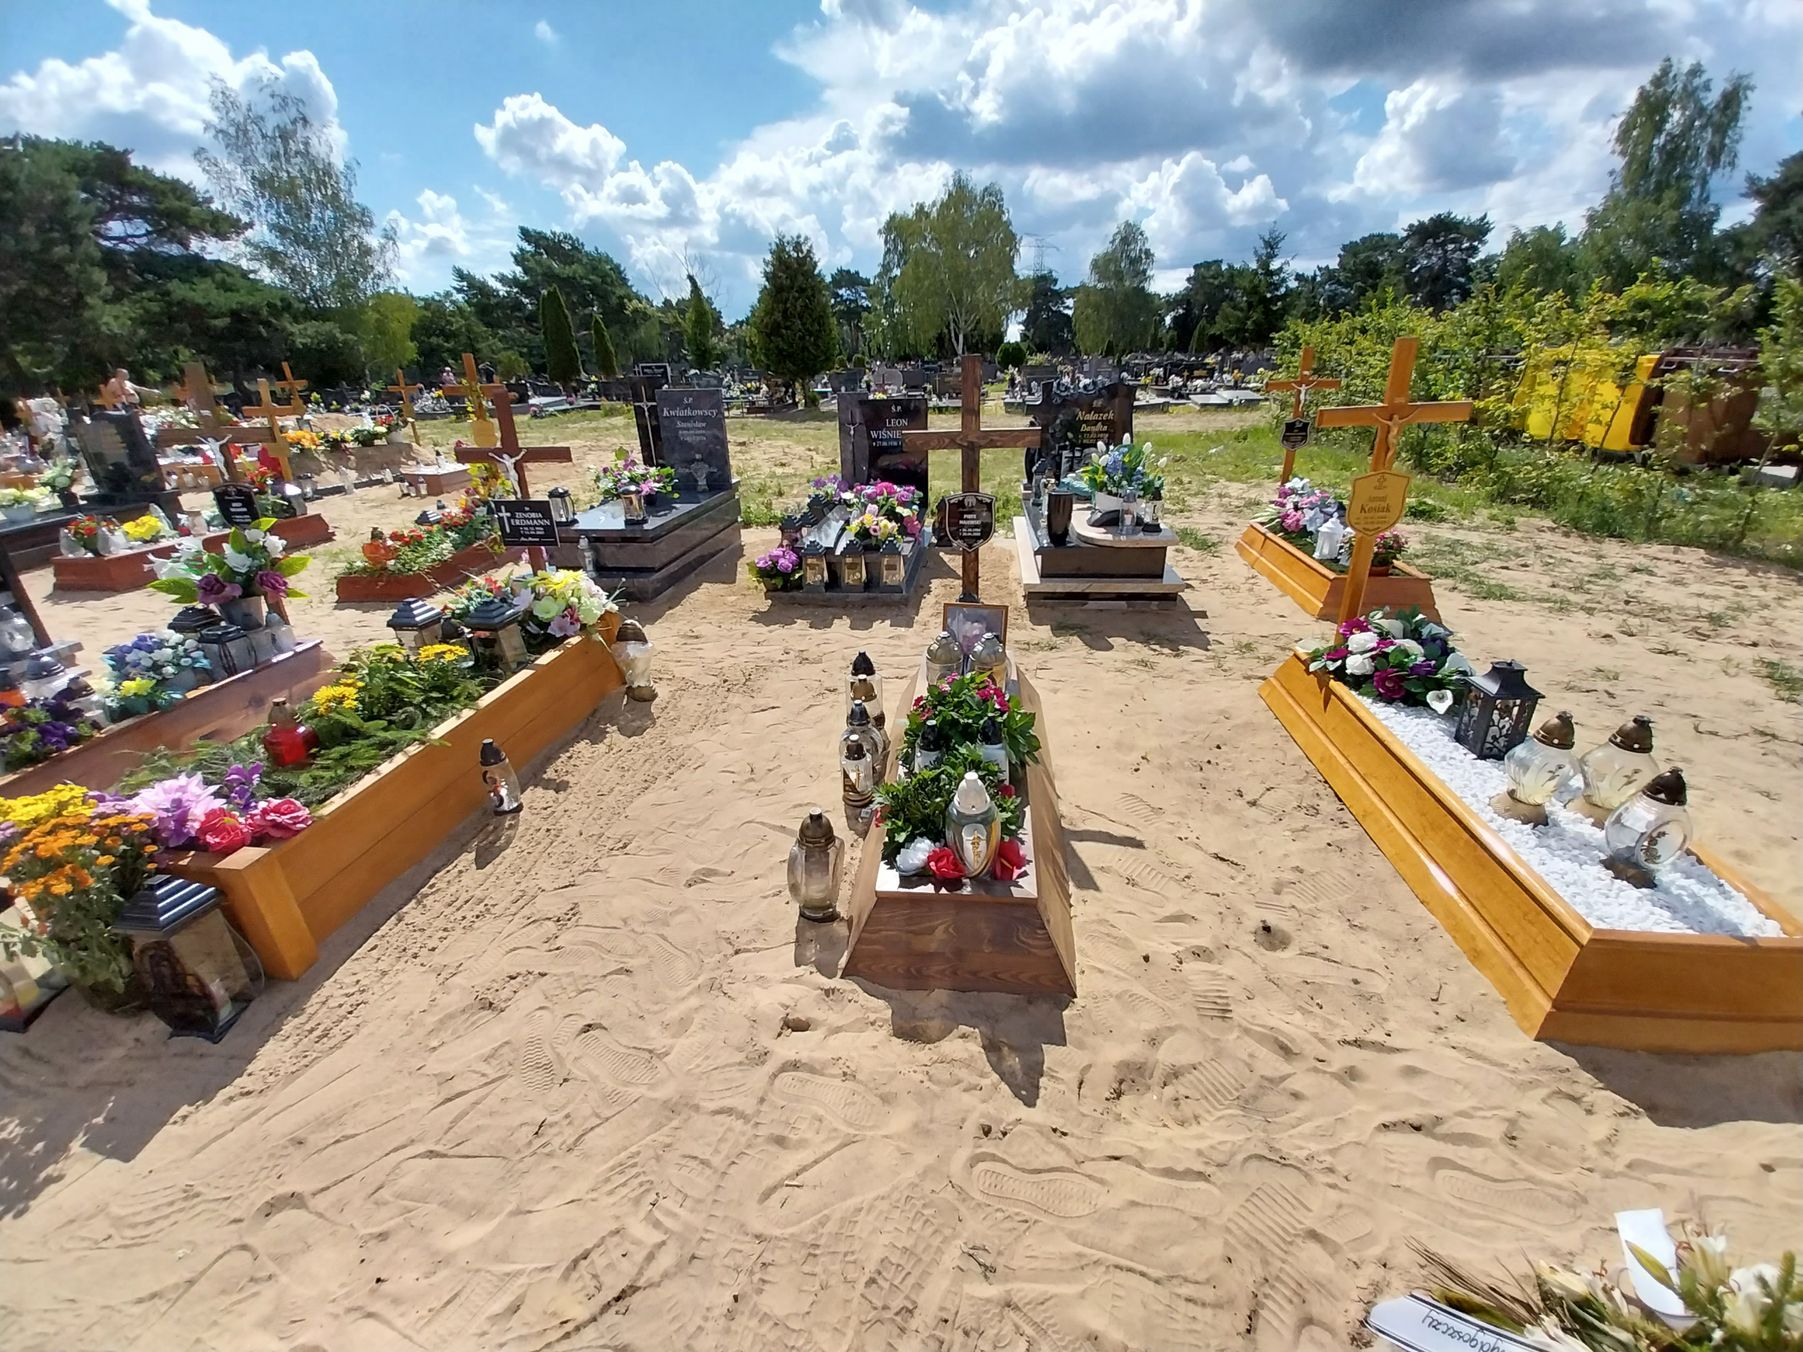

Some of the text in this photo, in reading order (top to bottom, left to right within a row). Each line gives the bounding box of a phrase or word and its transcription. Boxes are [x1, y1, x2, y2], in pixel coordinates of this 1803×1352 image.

[662, 406, 718, 418] Kwiatkowscy
[886, 418, 908, 427] LEON
[870, 427, 902, 439] WIŚNIE
[515, 511, 543, 519] ZENOBIA
[510, 518, 551, 526] ERDMANN
[1421, 1309, 1504, 1352] ydgoszczy
